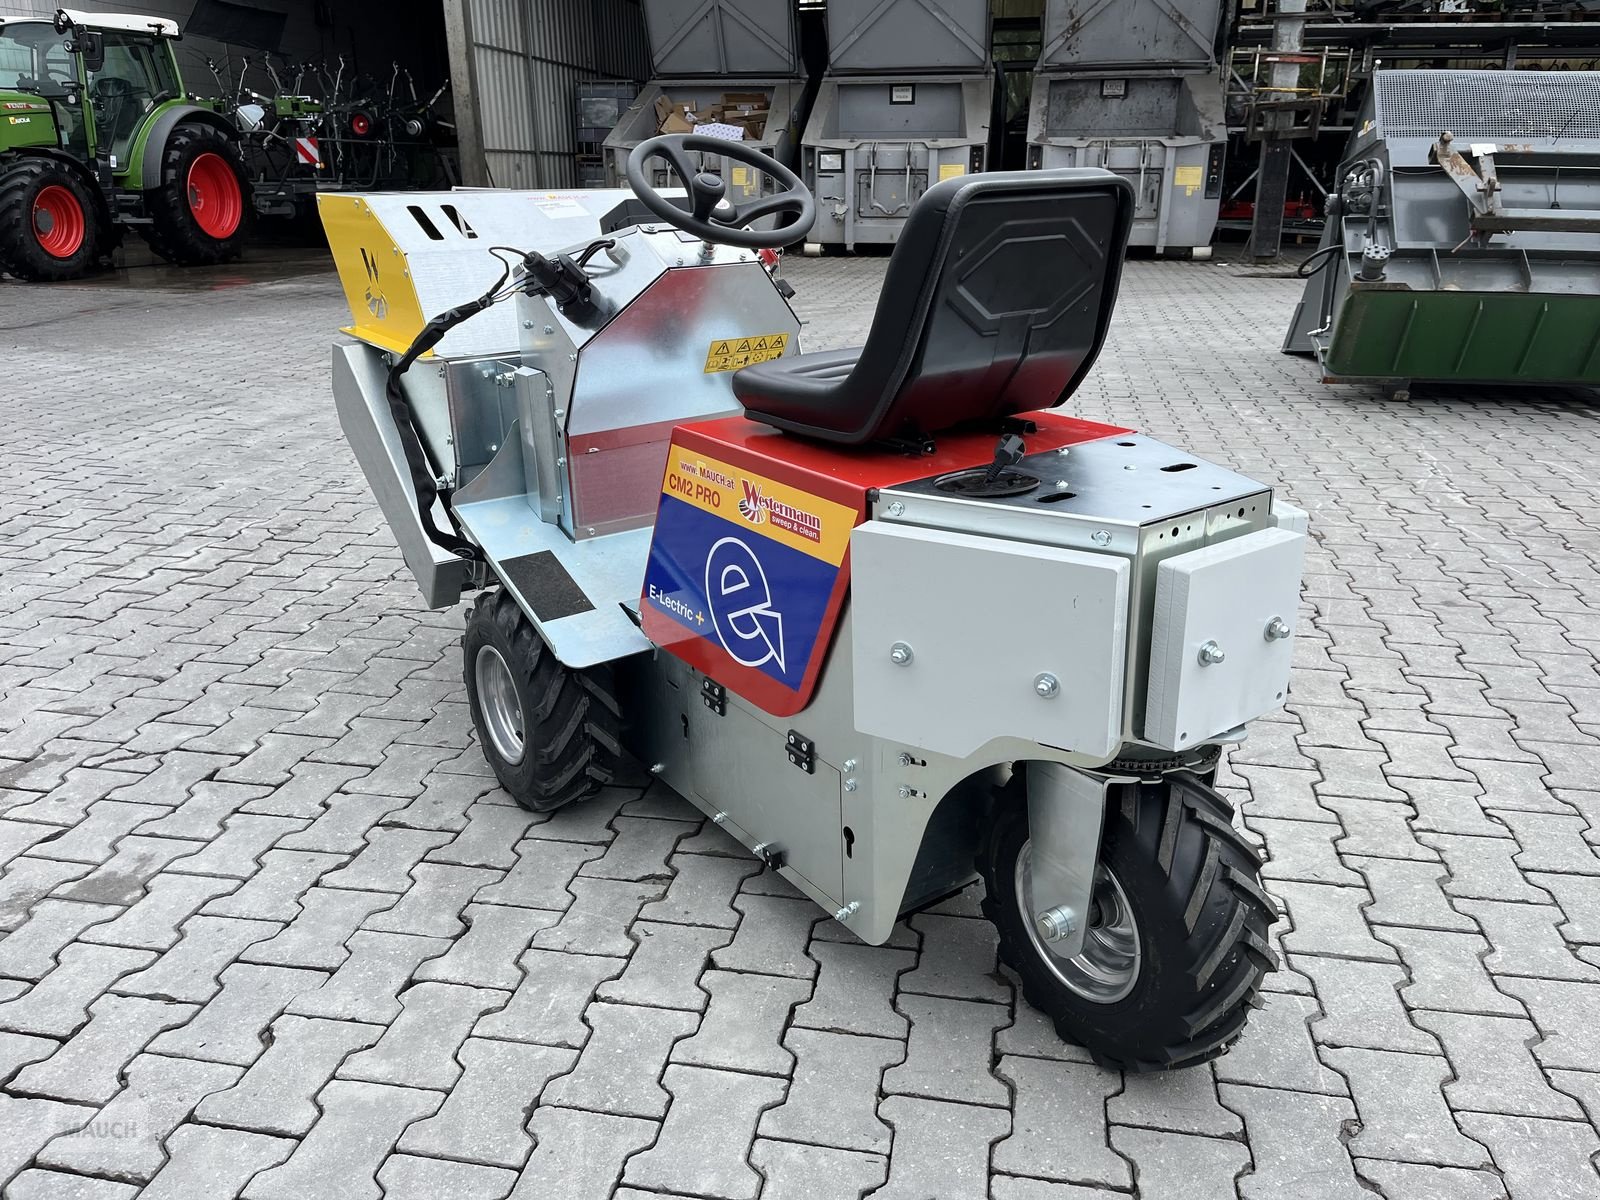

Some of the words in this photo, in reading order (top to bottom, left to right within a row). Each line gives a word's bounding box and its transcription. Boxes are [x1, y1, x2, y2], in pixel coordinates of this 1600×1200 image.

[669, 473, 693, 497] CM2
[696, 484, 721, 508] PRO
[742, 480, 820, 529] Westermann
[772, 516, 792, 530] sweep
[793, 523, 798, 532] &
[799, 527, 819, 540] clean.
[650, 583, 694, 621] E-Lectric
